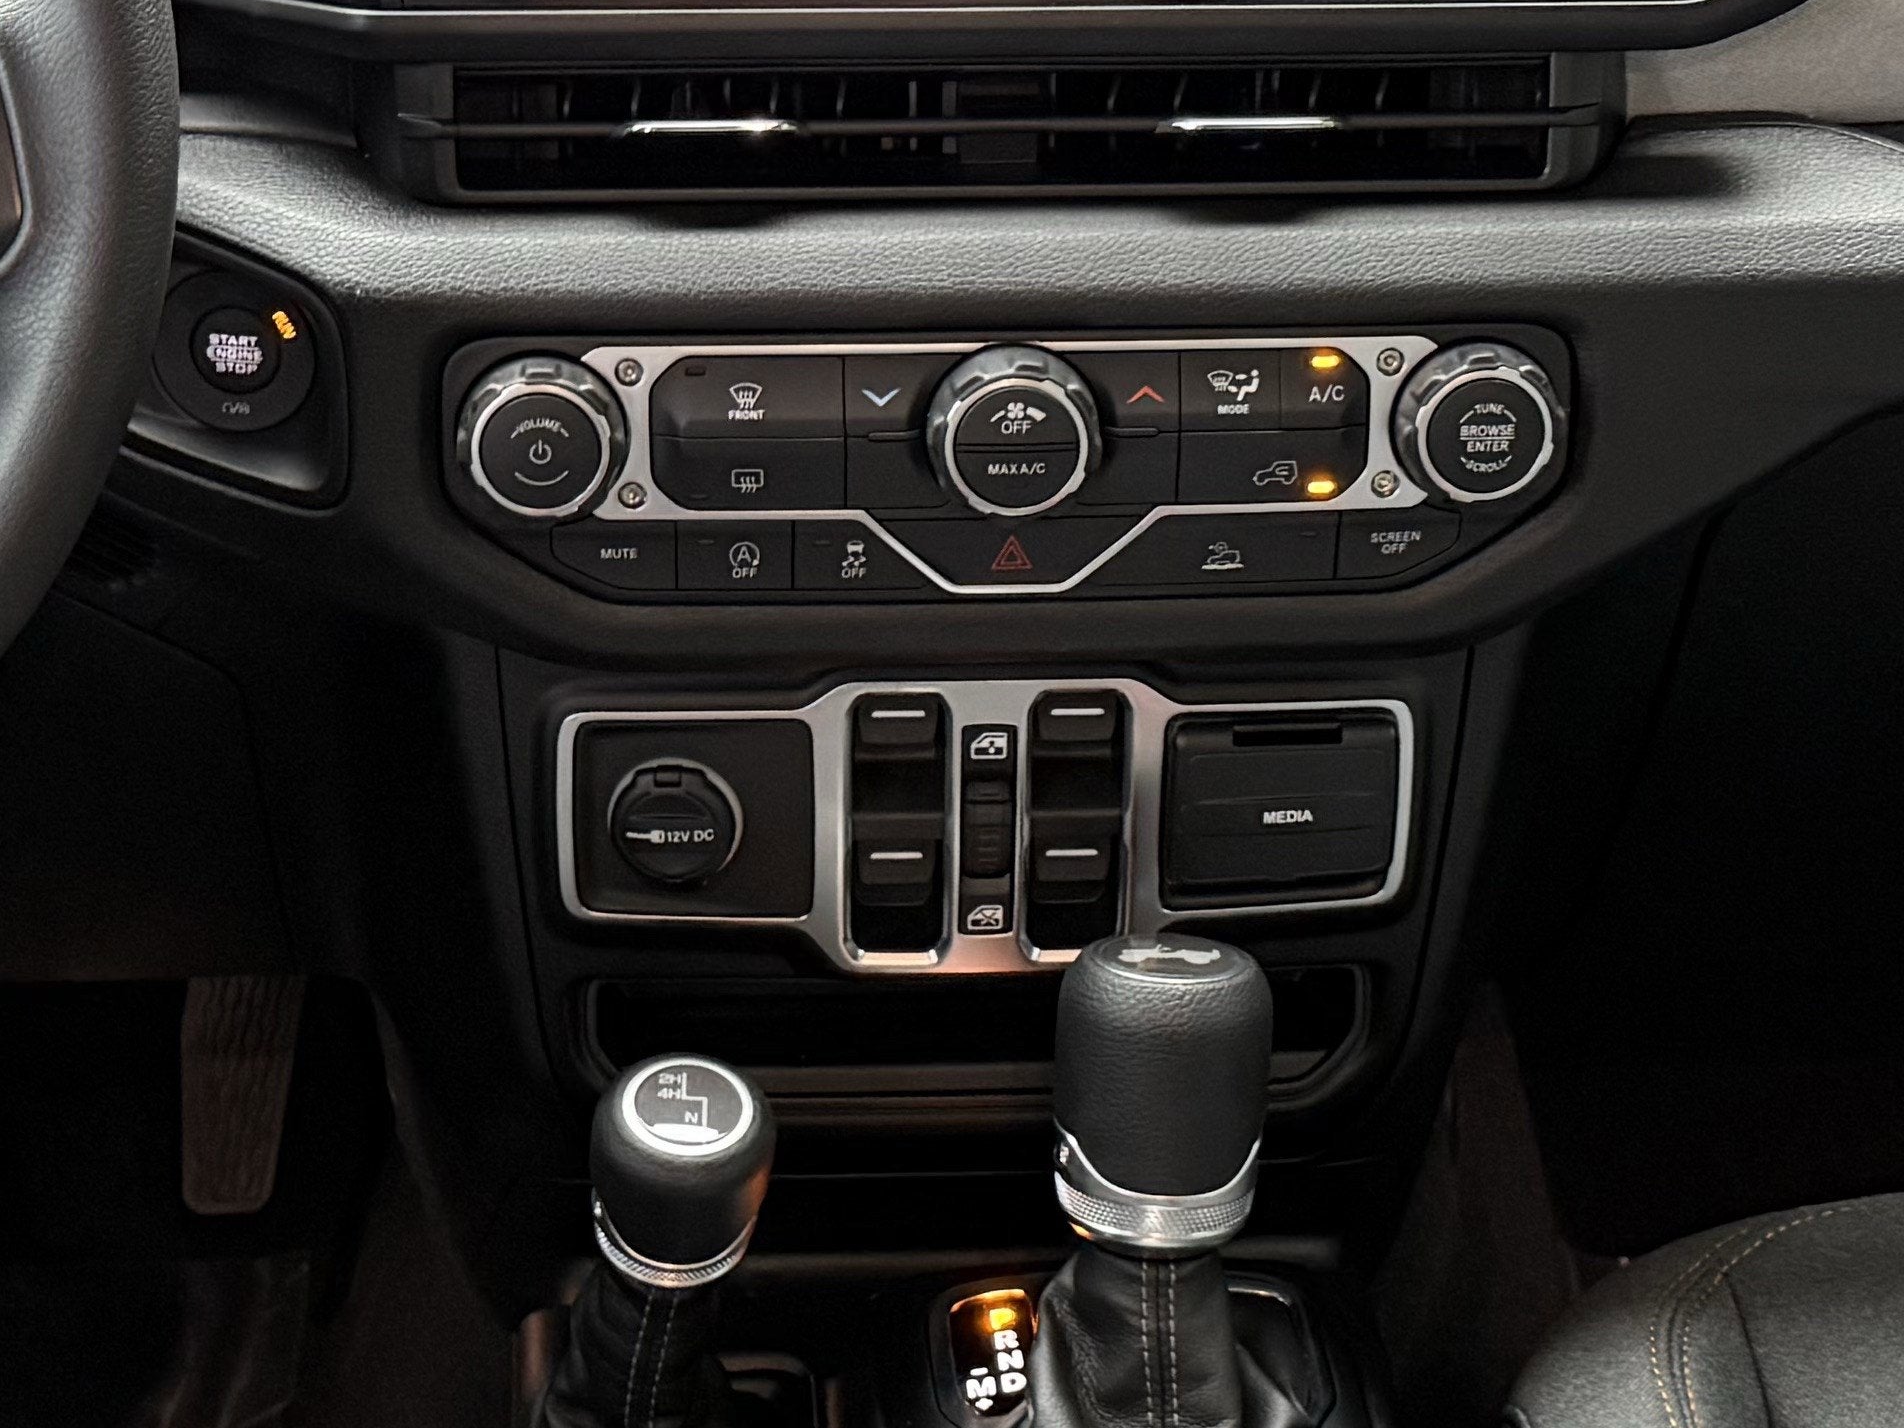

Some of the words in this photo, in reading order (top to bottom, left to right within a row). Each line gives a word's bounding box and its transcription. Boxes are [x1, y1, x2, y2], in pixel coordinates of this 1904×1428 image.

[271, 310, 297, 339] RUN
[208, 333, 258, 347] START
[206, 345, 263, 363] ENGINE
[215, 361, 258, 374] STOP
[1308, 384, 1346, 403] A/C
[728, 409, 766, 421] FRONT
[1217, 404, 1250, 415] MODE
[1474, 403, 1505, 415] TUNE
[515, 417, 564, 434] VOLUME
[1001, 421, 1032, 435] OFF
[1459, 424, 1516, 438] BROWSE
[1466, 439, 1510, 453] ENTER
[987, 463, 1018, 475] MAX
[1019, 463, 1046, 475] A/C
[1465, 458, 1508, 473] SCROLL
[1370, 530, 1421, 543] SCREEN
[600, 547, 638, 560] MUTE
[1381, 542, 1408, 555] OFF
[732, 566, 758, 579] OFF
[841, 566, 867, 579] OFF
[1263, 809, 1314, 824] MEDIA
[667, 830, 690, 843] 12V
[693, 829, 715, 843] DC
[657, 1087, 681, 1100] 4H
[684, 1111, 699, 1124] N
[989, 1307, 1016, 1330] P
[994, 1329, 1019, 1350] R
[997, 1349, 1024, 1371] N
[966, 1376, 997, 1399] M
[1000, 1372, 1027, 1393] D
